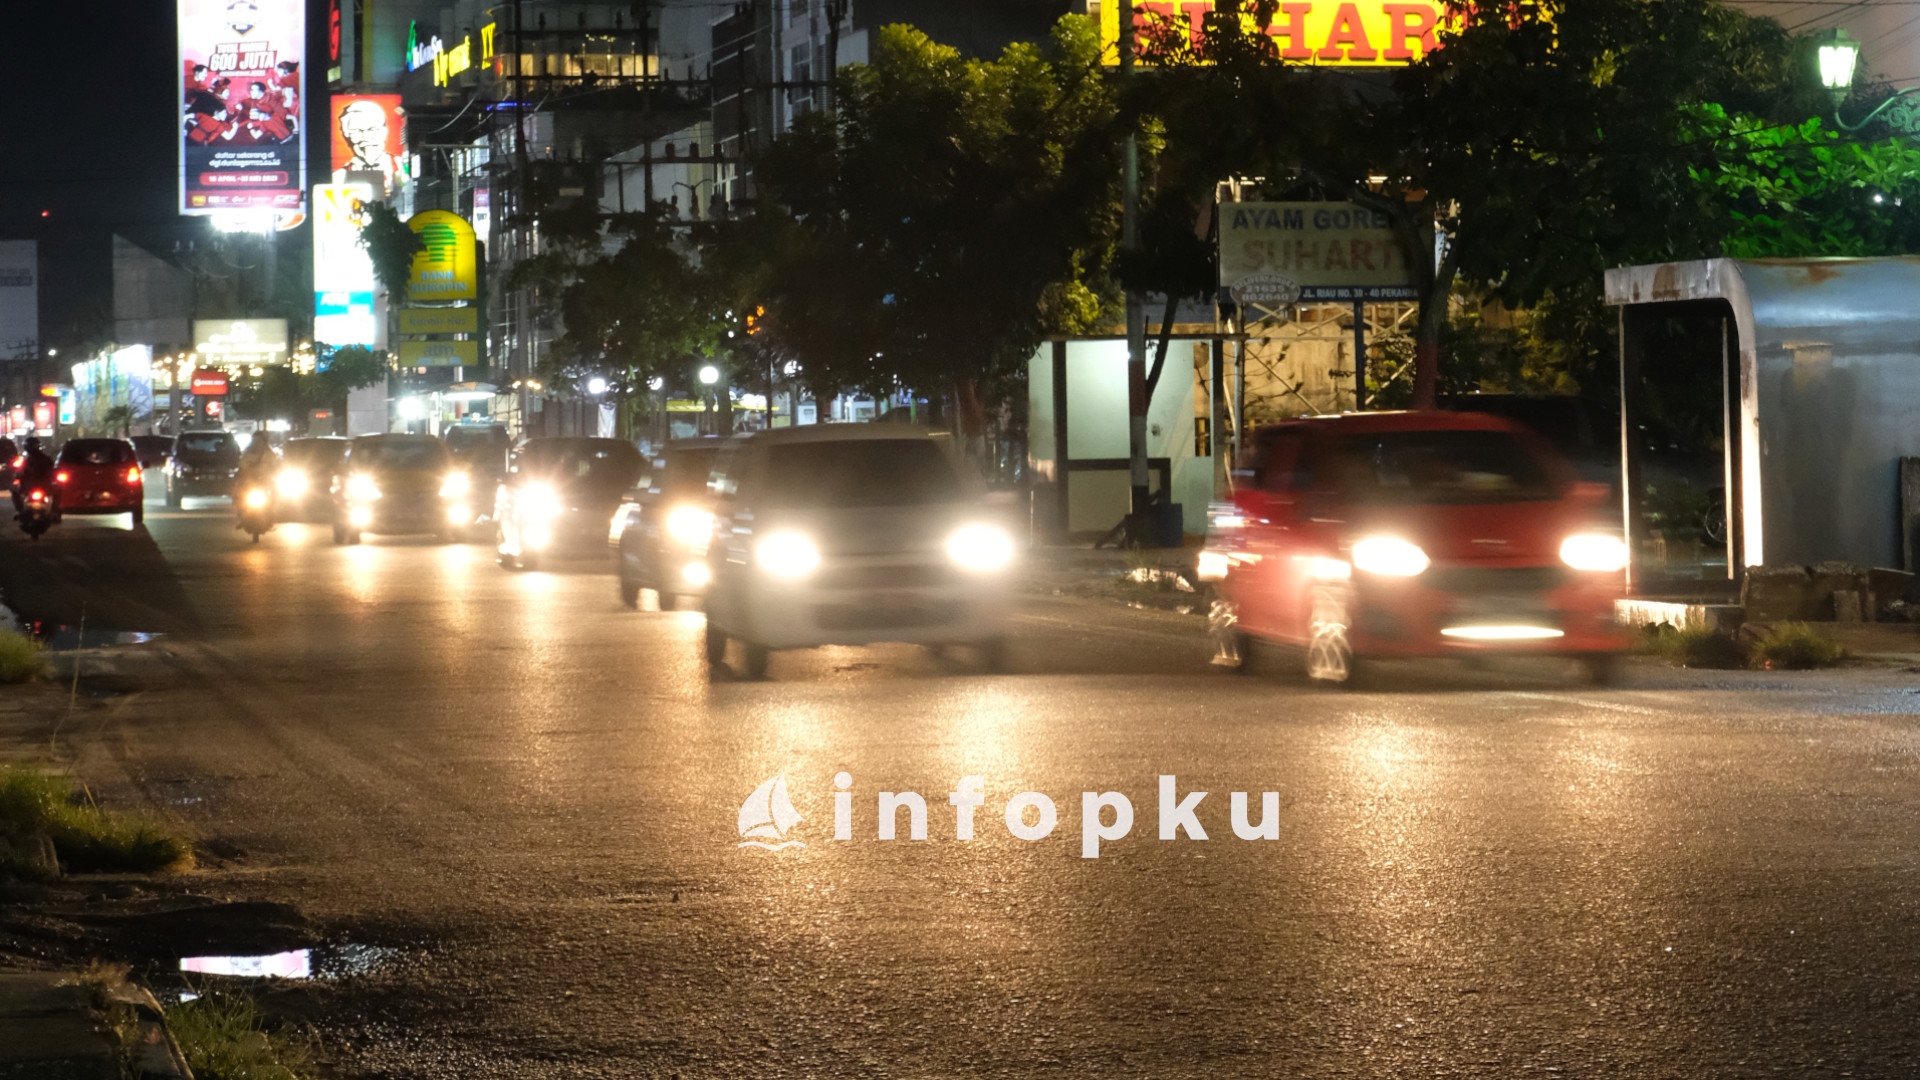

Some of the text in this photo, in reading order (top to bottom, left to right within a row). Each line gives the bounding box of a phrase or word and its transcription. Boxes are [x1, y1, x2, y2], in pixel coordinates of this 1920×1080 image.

[1132, 1, 1522, 58] SHAR
[211, 51, 274, 71] 600 JUTA
[1232, 209, 1304, 230] AYAM
[421, 270, 455, 281] BANK
[1302, 288, 1315, 298] JL.
[1316, 288, 1336, 298] RIAU
[1337, 288, 1352, 298] NO.
[1369, 288, 1379, 298] 40
[1381, 288, 1420, 298] PEKANBA
